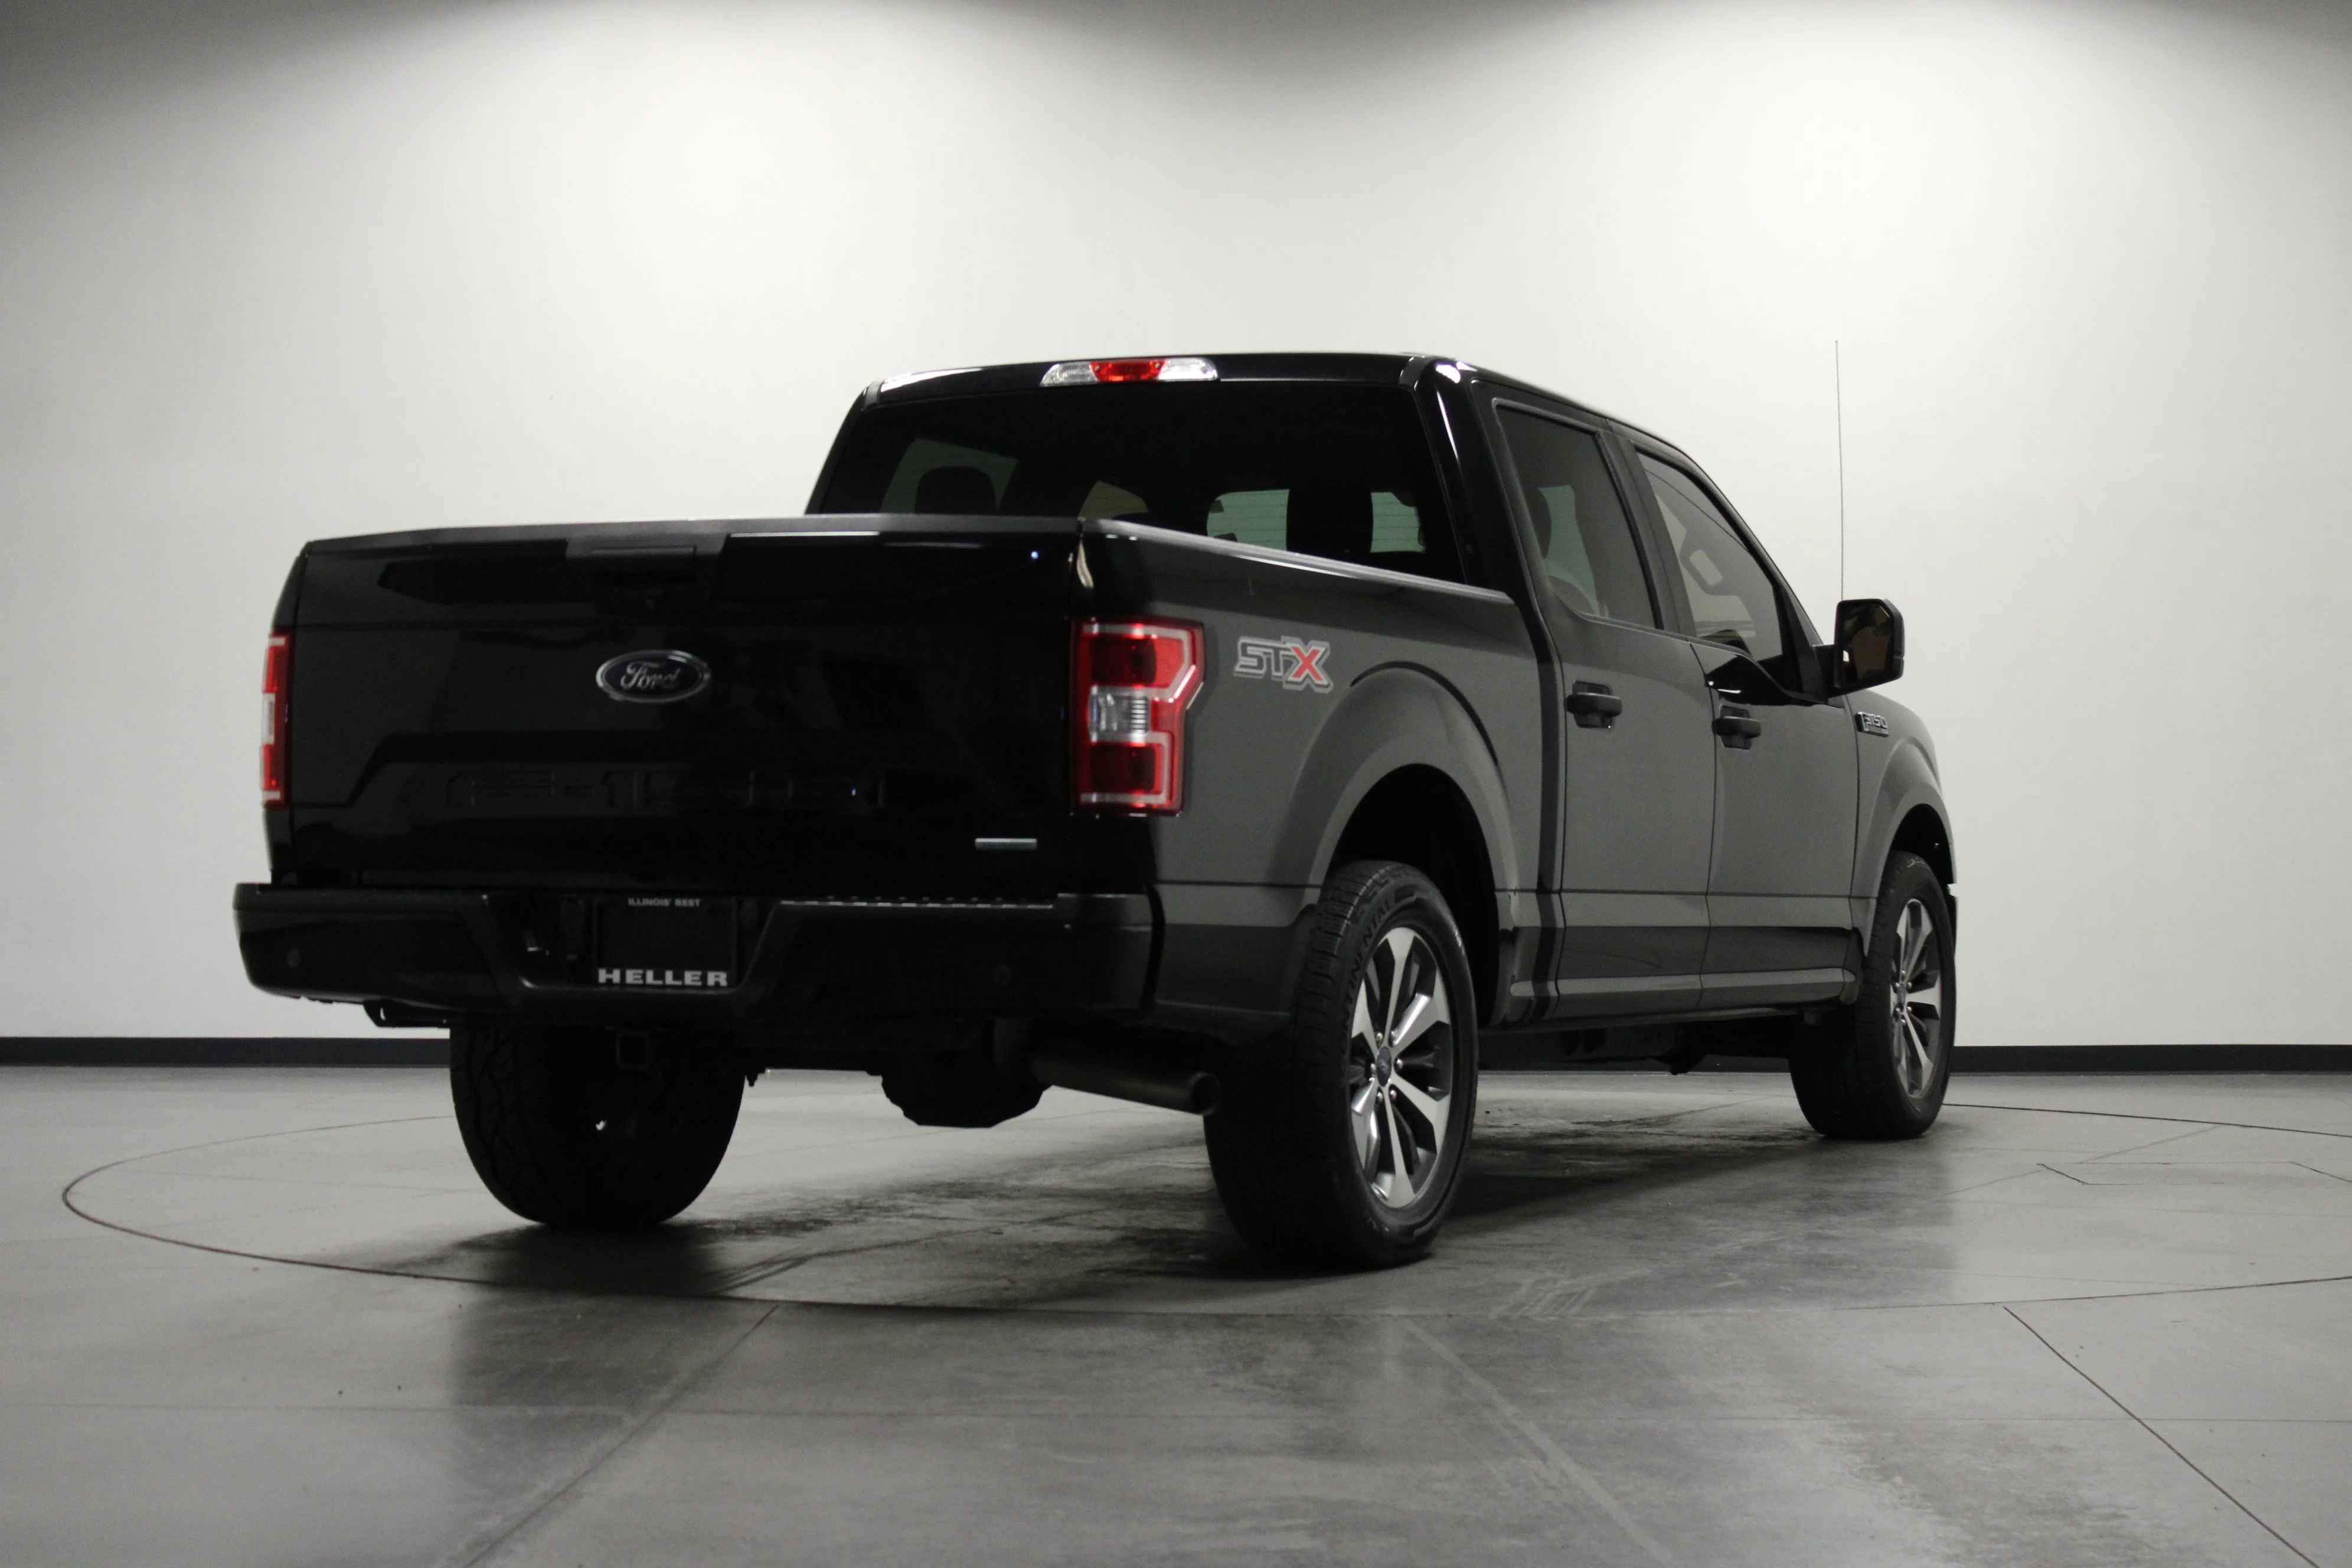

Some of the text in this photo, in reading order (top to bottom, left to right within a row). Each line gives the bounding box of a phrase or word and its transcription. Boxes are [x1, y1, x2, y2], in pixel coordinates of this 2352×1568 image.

[620, 661, 682, 690] Ford
[1233, 635, 1333, 694] STX
[675, 897, 701, 907] BEST
[597, 968, 728, 986] HELLER
